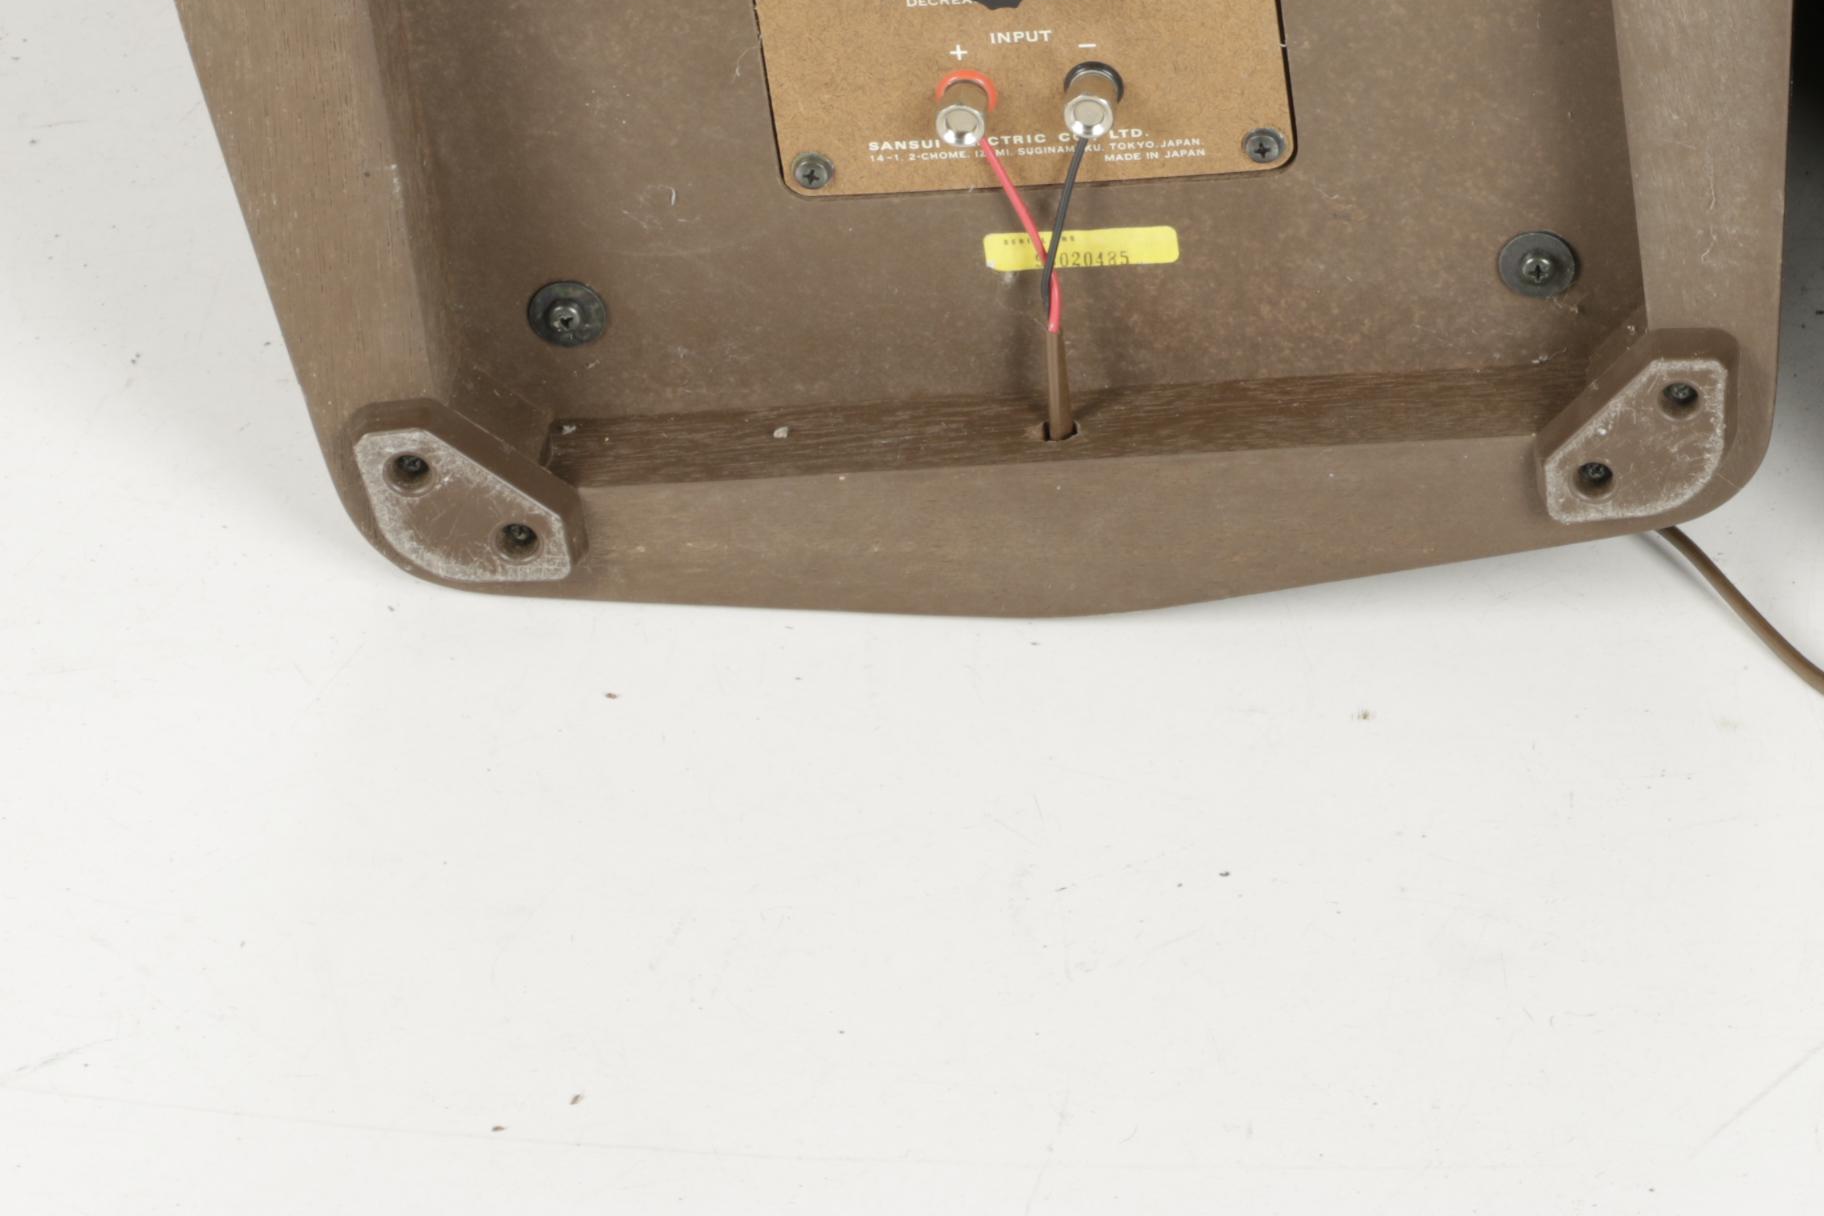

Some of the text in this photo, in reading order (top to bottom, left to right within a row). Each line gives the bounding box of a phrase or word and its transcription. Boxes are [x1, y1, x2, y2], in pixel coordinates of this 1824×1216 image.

[990, 30, 1052, 44] INPUT
[869, 139, 940, 151] SANSUI
[1109, 128, 1149, 139] LTD.
[1105, 153, 1141, 162] MADE
[1165, 149, 1206, 159] JAPAN
